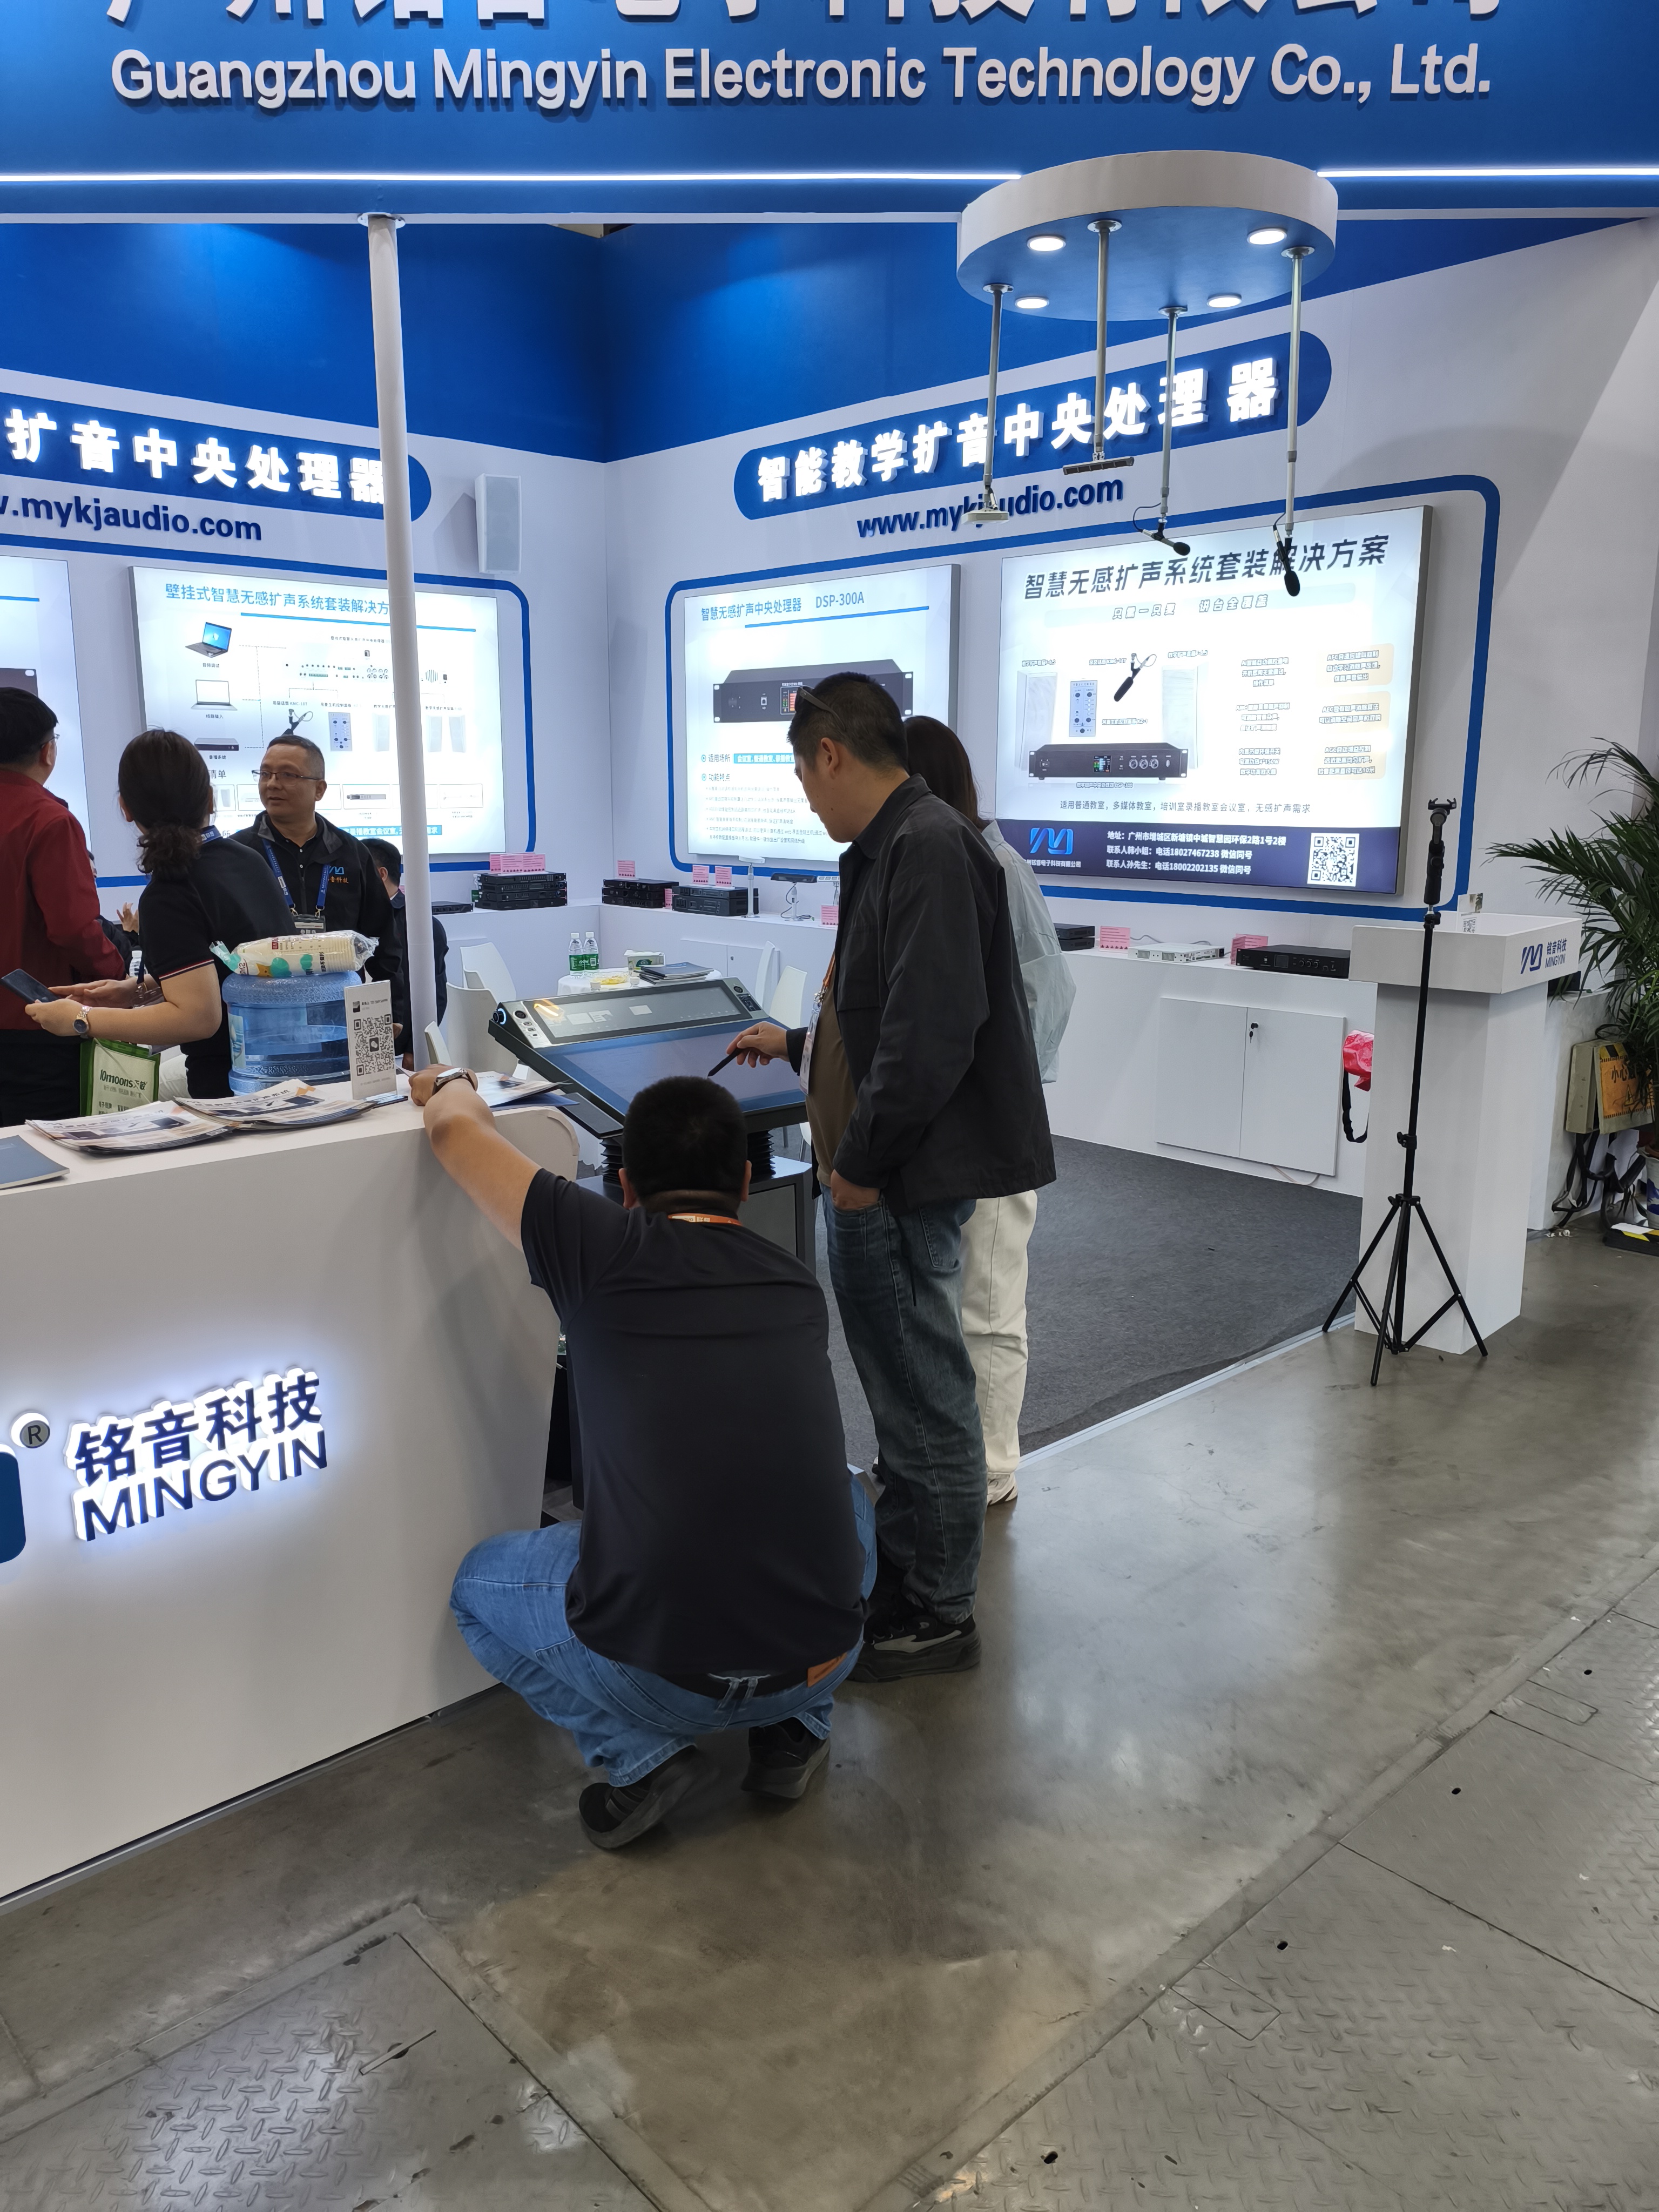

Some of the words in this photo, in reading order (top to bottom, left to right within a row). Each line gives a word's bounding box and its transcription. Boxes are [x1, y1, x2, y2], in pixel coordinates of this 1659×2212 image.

[112, 49, 415, 109] Guangzhou
[434, 48, 646, 109] Mingyin
[665, 47, 926, 99] Electronic
[943, 45, 1256, 106] Technology
[1271, 43, 1371, 103] Co.,
[1391, 43, 1491, 94] Ltd.
[702, 597, 802, 621] 智慧无感扩声中央处理器
[816, 591, 865, 609] DSP-300A
[1198, 594, 1269, 613] 讲台全覆盖
[708, 753, 730, 763] 适用场所
[709, 773, 731, 782] 功能特点
[1220, 849, 1253, 860] 微信同号
[1219, 864, 1252, 875] 微信同号
[327, 875, 349, 884] 音科技
[1547, 938, 1567, 955] 铭音科技
[1545, 954, 1566, 968] MINGYIN
[75, 1374, 322, 1487] 铭音科技
[81, 1429, 327, 1542] MINGYIN
